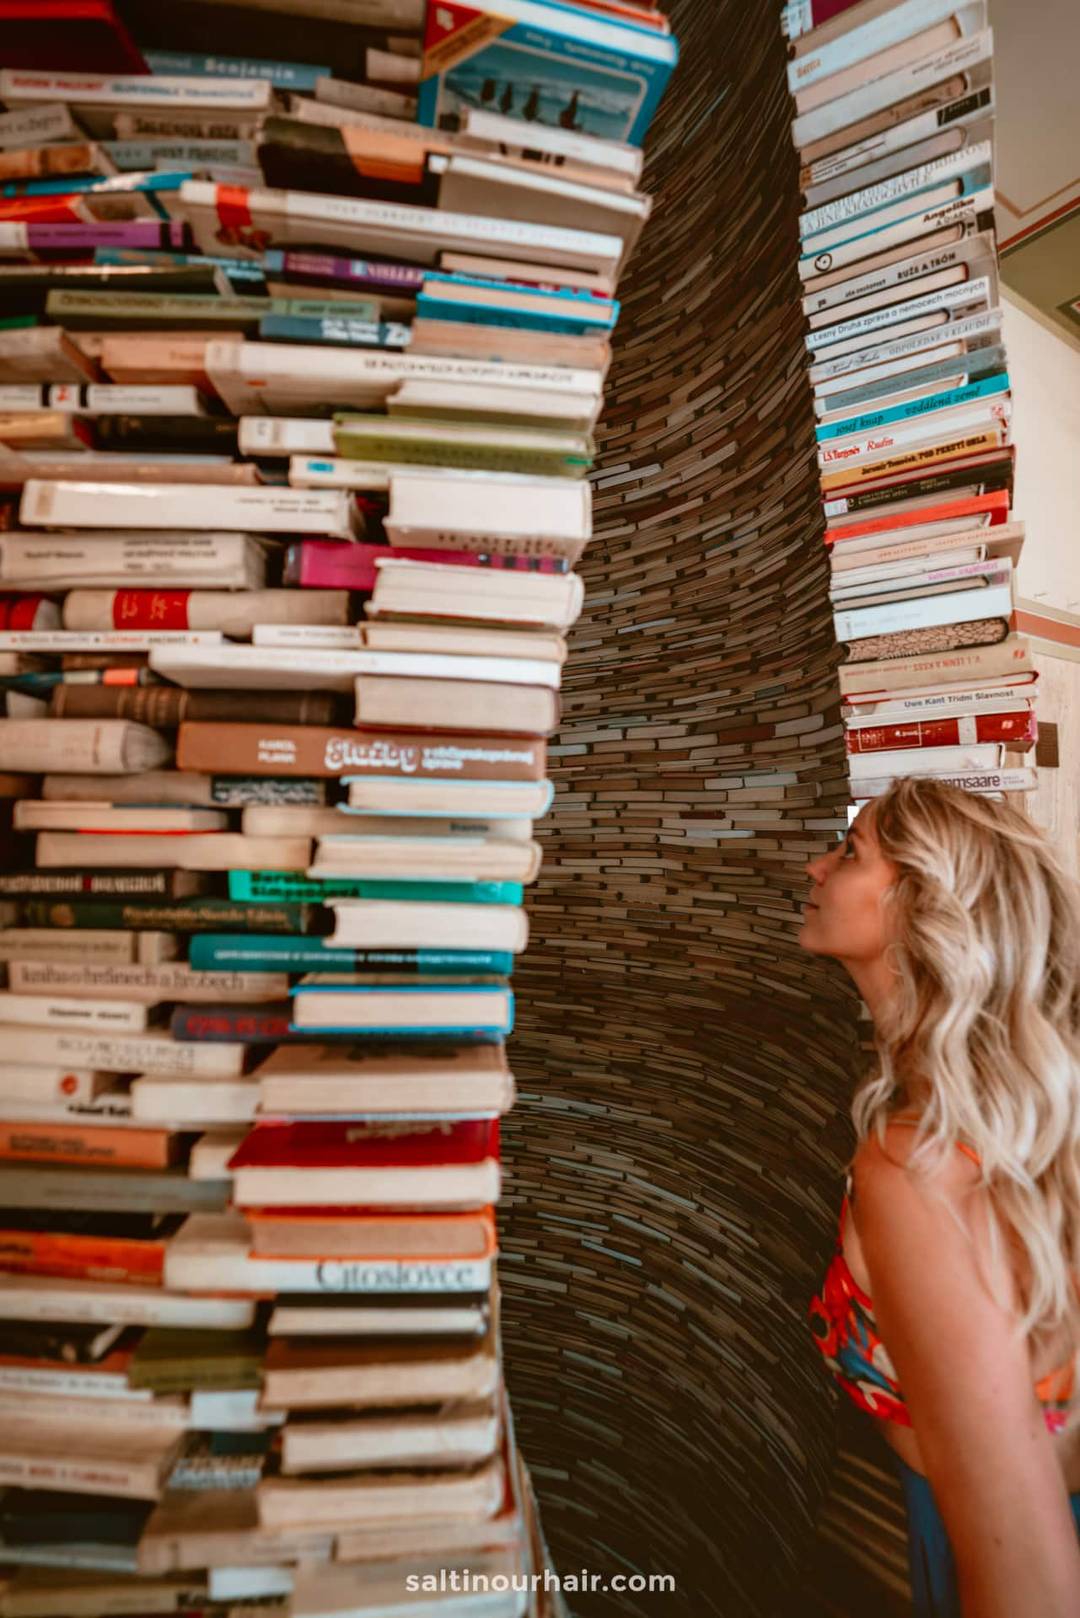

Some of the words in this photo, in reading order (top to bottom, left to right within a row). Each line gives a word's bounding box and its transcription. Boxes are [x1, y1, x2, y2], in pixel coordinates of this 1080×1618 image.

[923, 198, 975, 223] Angelika
[899, 295, 942, 313] nemocech
[866, 436, 894, 452] Rudin
[904, 699, 923, 708] Uwe
[925, 696, 945, 705] Kant
[975, 690, 1014, 700] Slavnost
